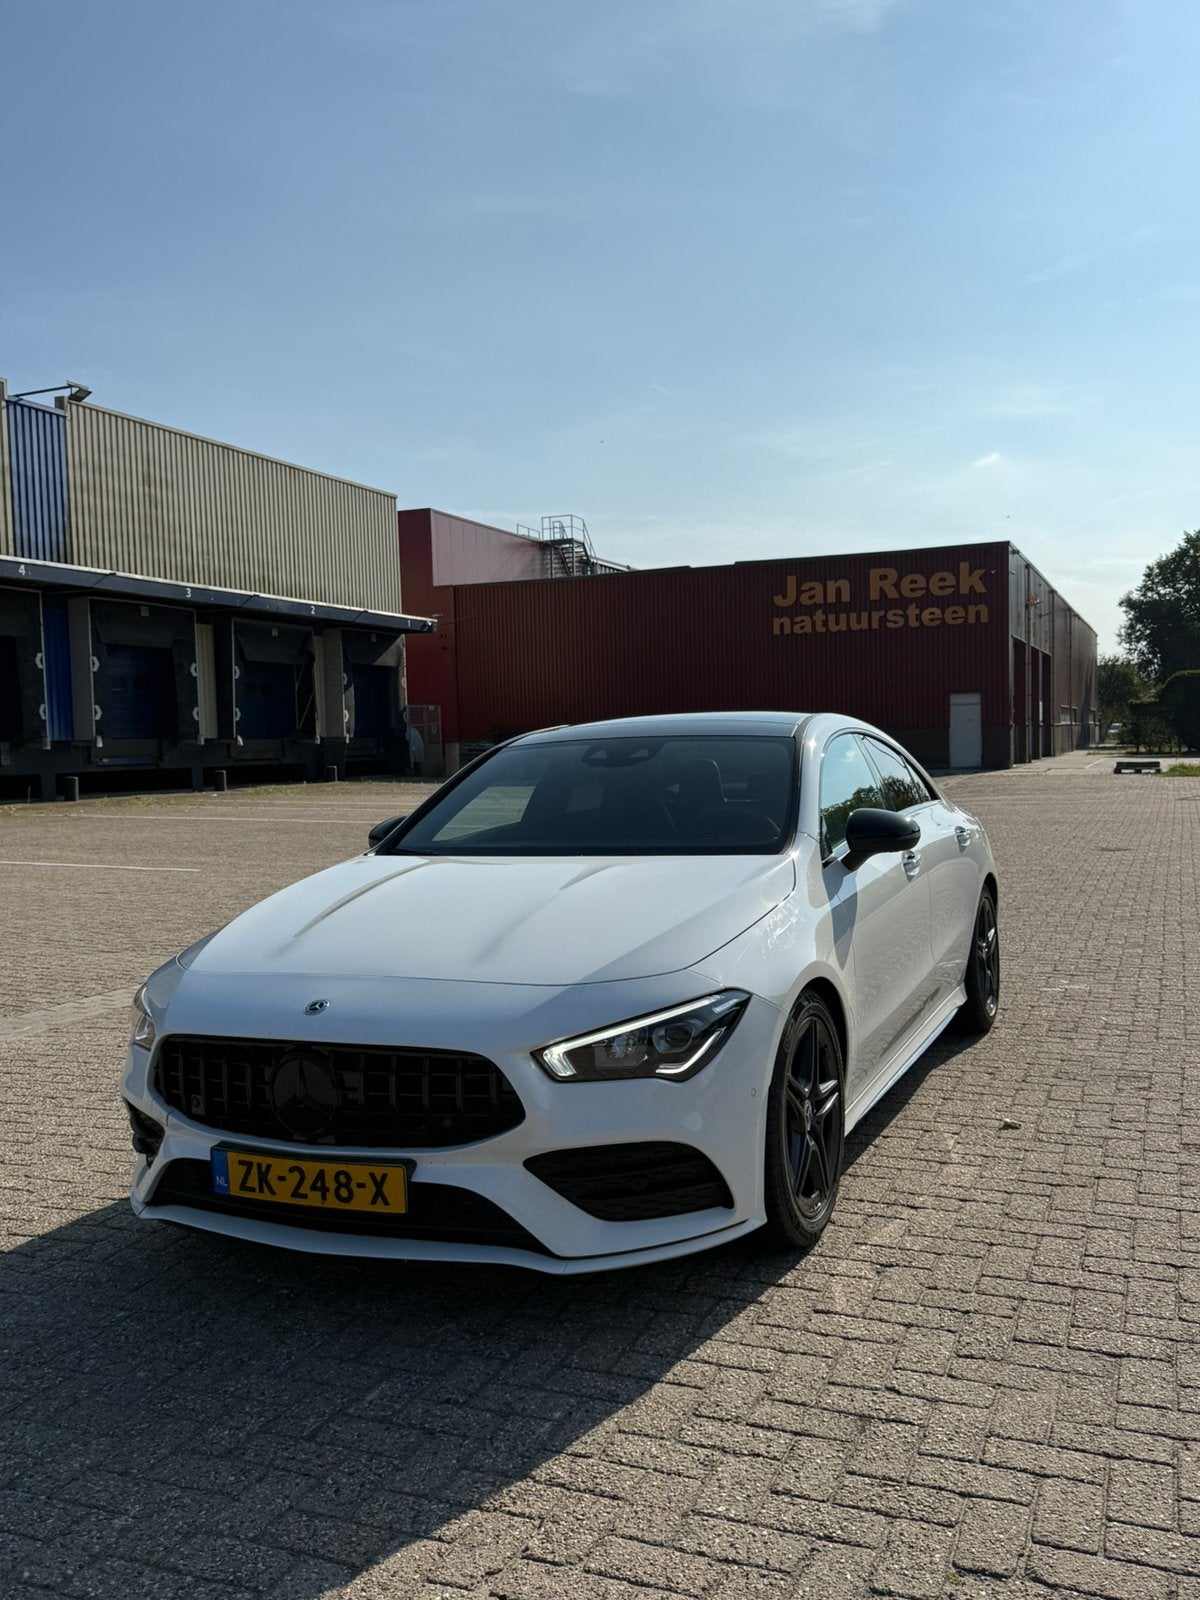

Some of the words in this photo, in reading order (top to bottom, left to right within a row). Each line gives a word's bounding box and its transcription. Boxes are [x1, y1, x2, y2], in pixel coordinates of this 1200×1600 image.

[18, 564, 26, 576] 4
[773, 575, 850, 607] Jan
[869, 561, 988, 600] Reek
[185, 587, 192, 598] 3
[310, 605, 316, 615] 2
[772, 602, 989, 635] natuursteen
[216, 1175, 228, 1187] NL
[238, 1160, 391, 1206] ZK-248-X
